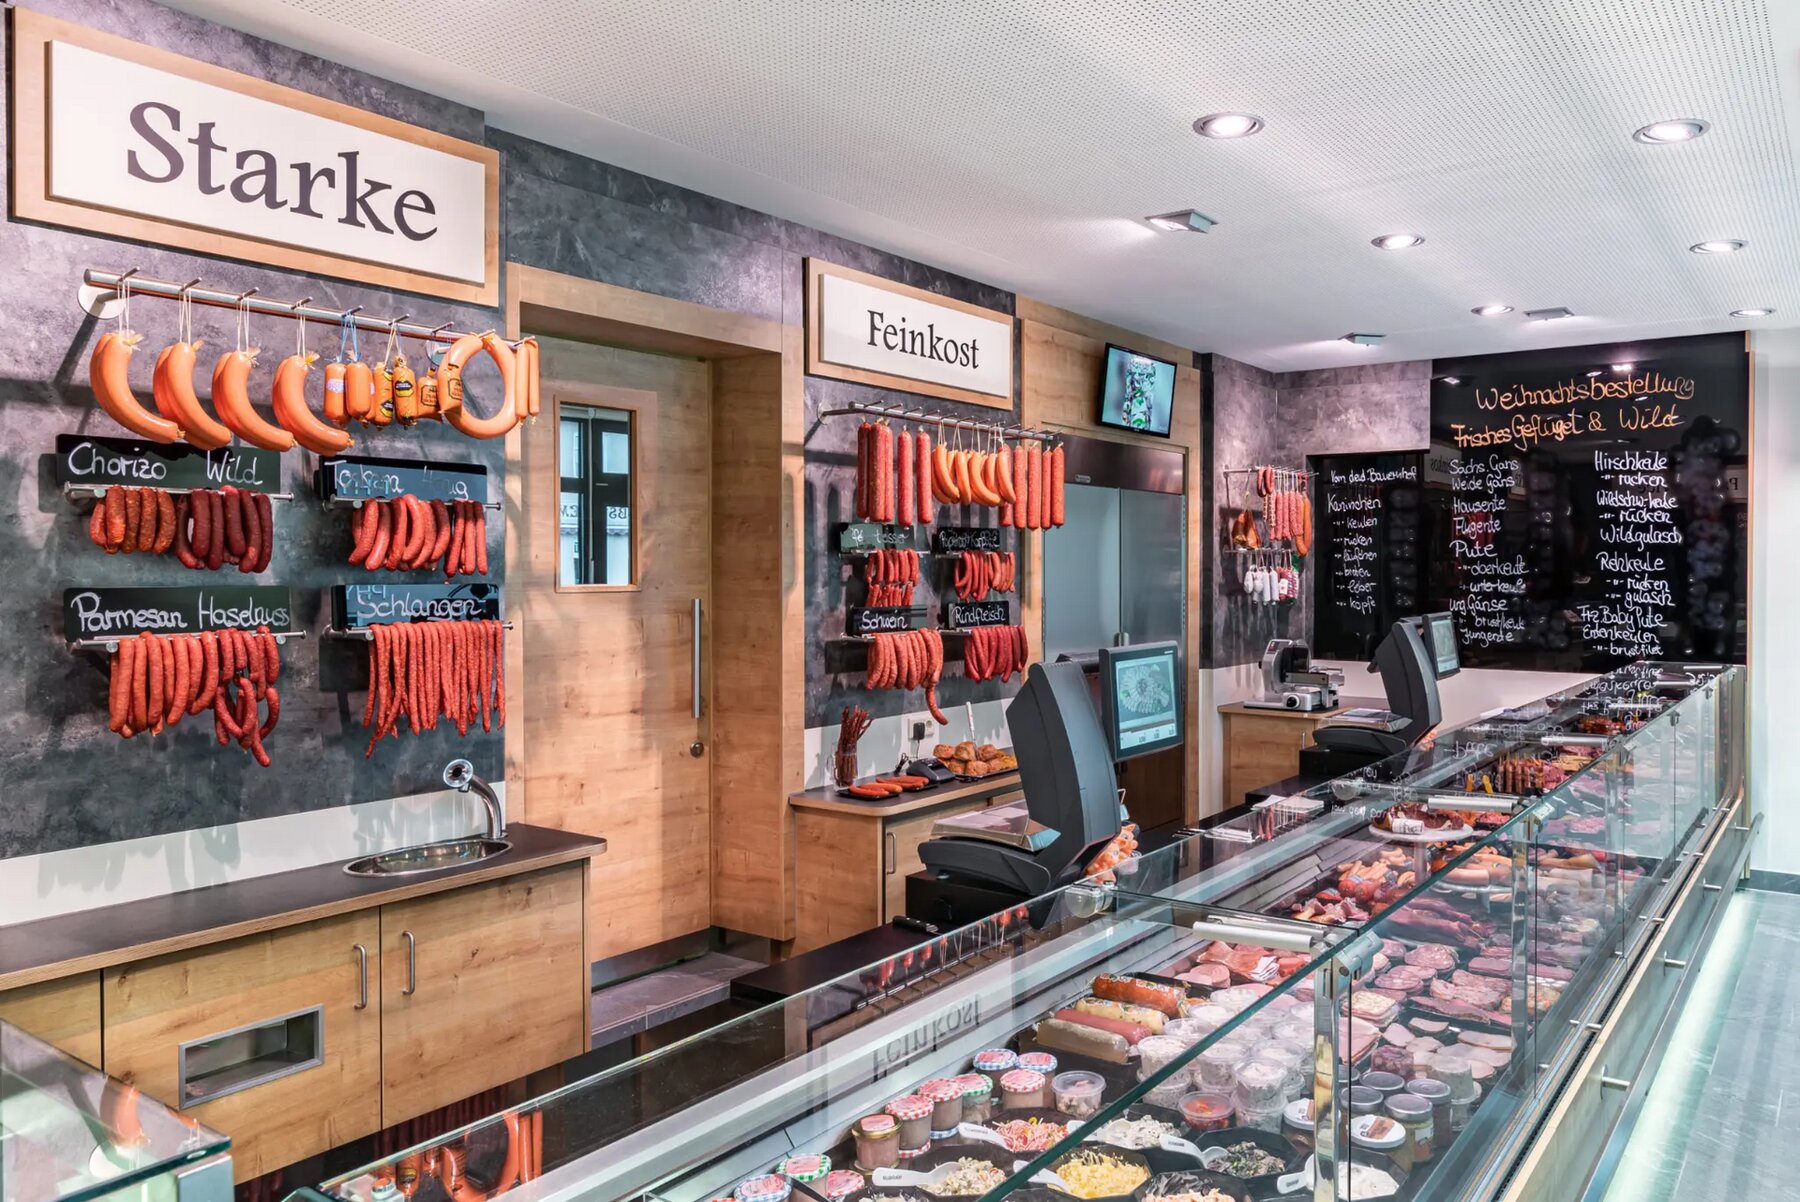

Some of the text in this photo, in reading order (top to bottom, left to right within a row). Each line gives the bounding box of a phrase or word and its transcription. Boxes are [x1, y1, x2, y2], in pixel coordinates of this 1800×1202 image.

[127, 101, 438, 242] Starke
[867, 309, 980, 370] Feinkost
[1476, 373, 1695, 410] Weihnachtsbestellung
[1588, 411, 1607, 432] &
[1619, 404, 1687, 430] Wild
[67, 442, 264, 486] Chorizo Wild
[1489, 453, 1519, 479] Gans
[1486, 474, 1516, 494] Gans
[1327, 493, 1382, 513] Kaninchen
[1453, 494, 1507, 514] Hausente
[1453, 514, 1502, 539] Flugente
[1600, 524, 1683, 552] Wildgulasch
[1449, 540, 1498, 557] Pute
[1595, 551, 1666, 573] Rehkeule
[356, 591, 482, 620] Schlangen
[1624, 589, 1676, 609] gulasch
[70, 591, 290, 633] Parmesan Haselnuss
[861, 609, 908, 630] Schwein
[951, 605, 1006, 626] Rindfleisch
[1628, 605, 1668, 628] Pute
